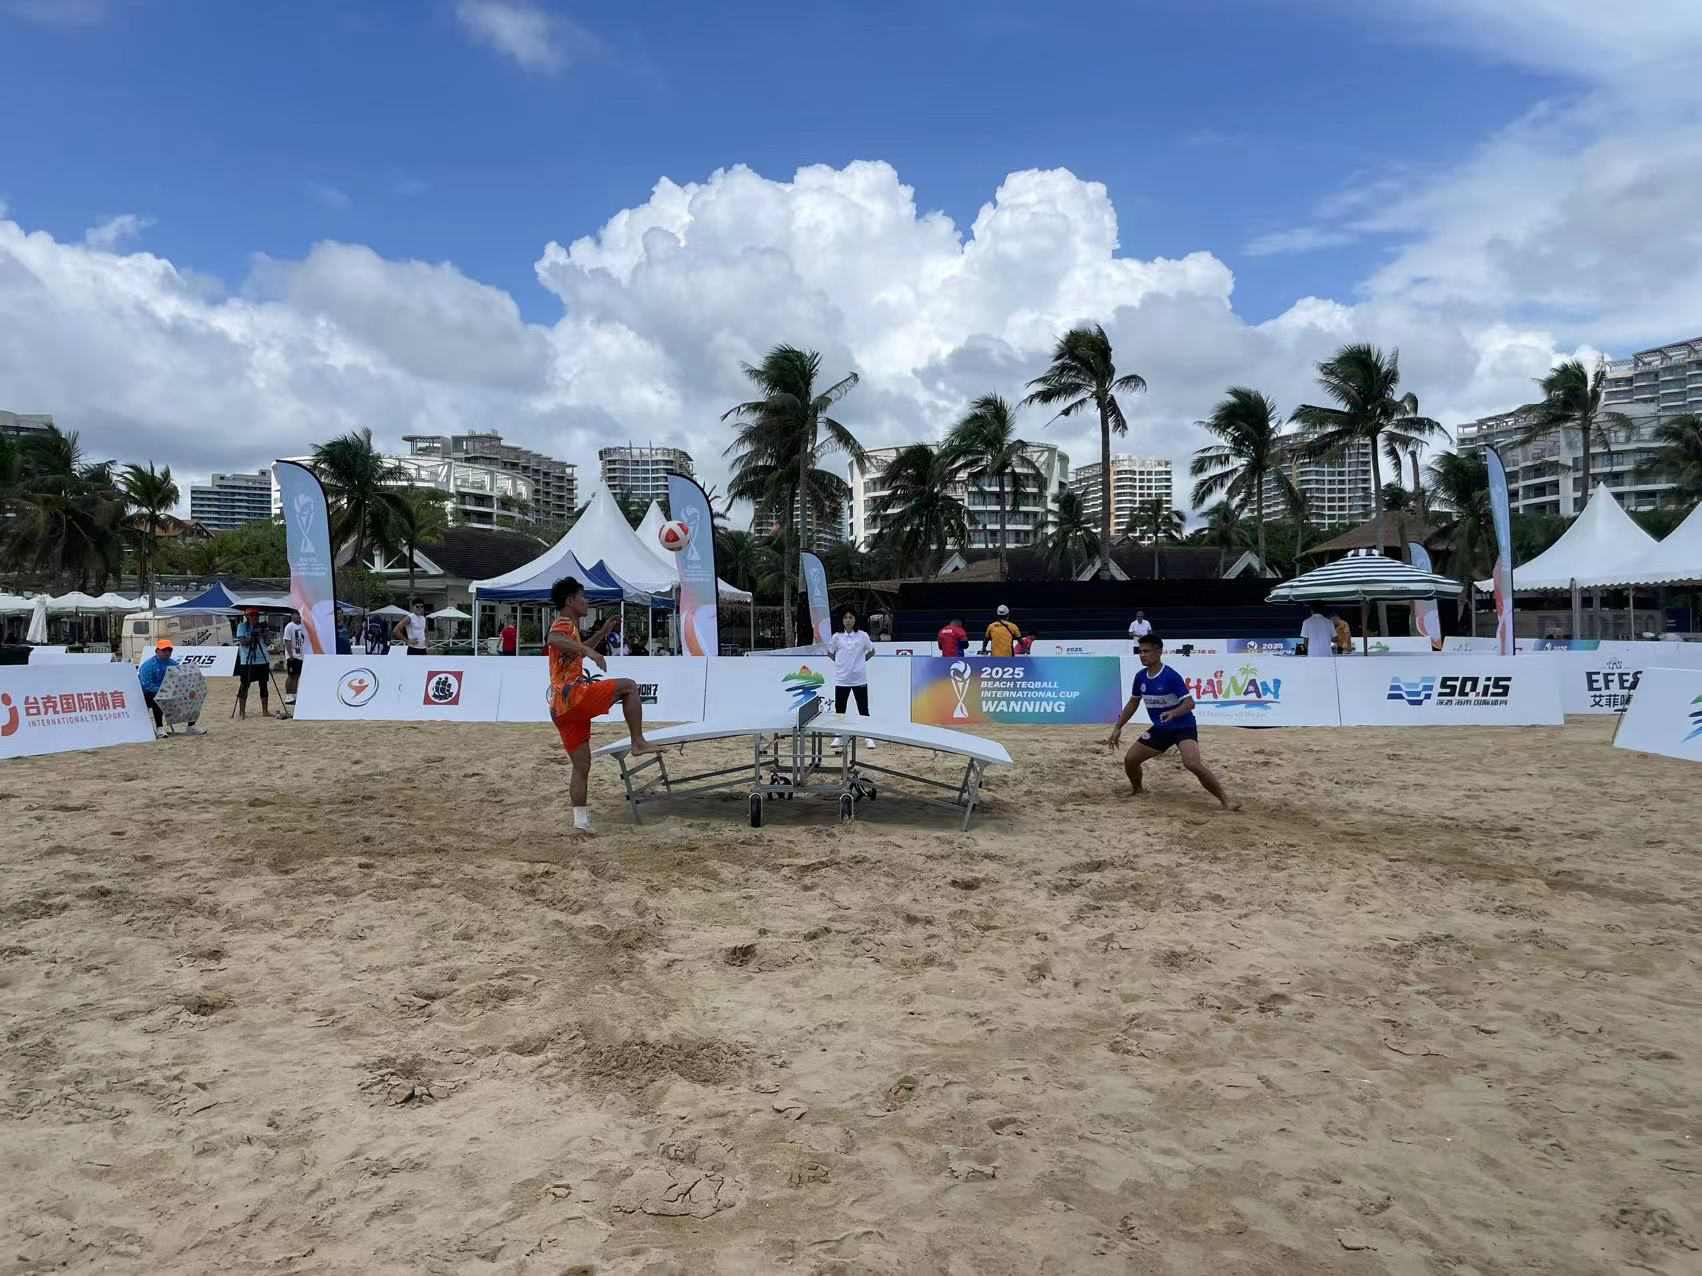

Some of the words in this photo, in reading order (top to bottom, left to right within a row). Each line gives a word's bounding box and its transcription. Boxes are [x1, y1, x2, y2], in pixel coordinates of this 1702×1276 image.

[980, 667, 1024, 678] 2025
[1015, 681, 1059, 689] TEQBALL
[981, 690, 1057, 698] INTERNATIONAL
[1059, 690, 1080, 698] CUP
[24, 690, 127, 716] 台克国际体育
[981, 700, 1066, 713] WANNING
